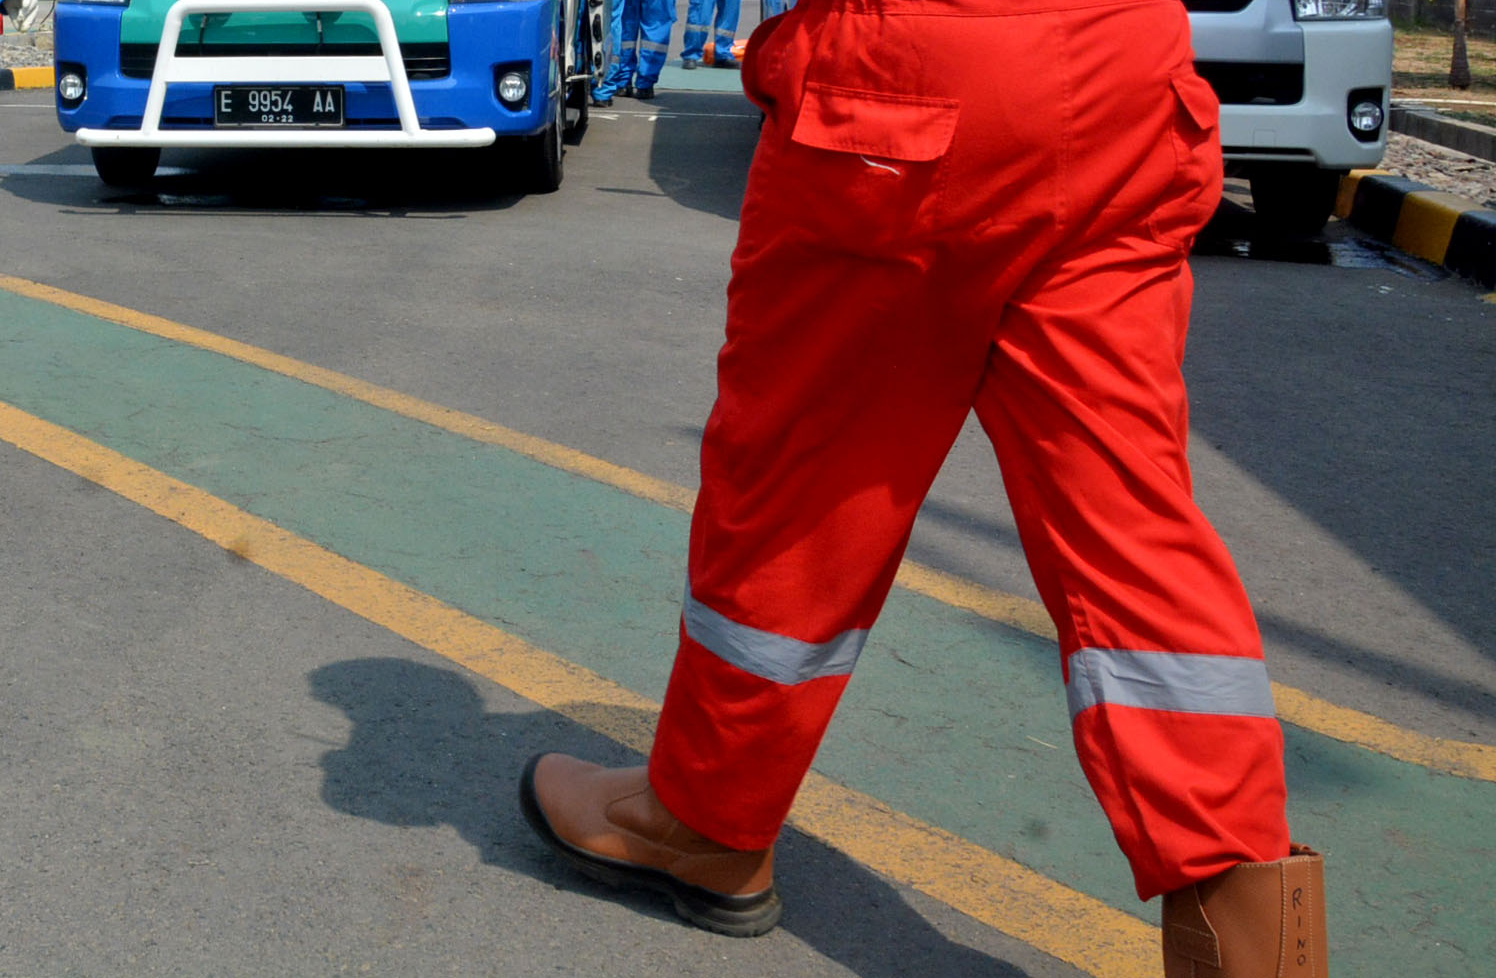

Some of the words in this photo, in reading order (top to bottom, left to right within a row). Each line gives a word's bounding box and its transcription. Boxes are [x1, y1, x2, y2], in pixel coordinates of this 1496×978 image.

[221, 90, 233, 113] E
[248, 90, 294, 113] 9954
[312, 90, 336, 113] AA
[1292, 887, 1307, 967] RINO
